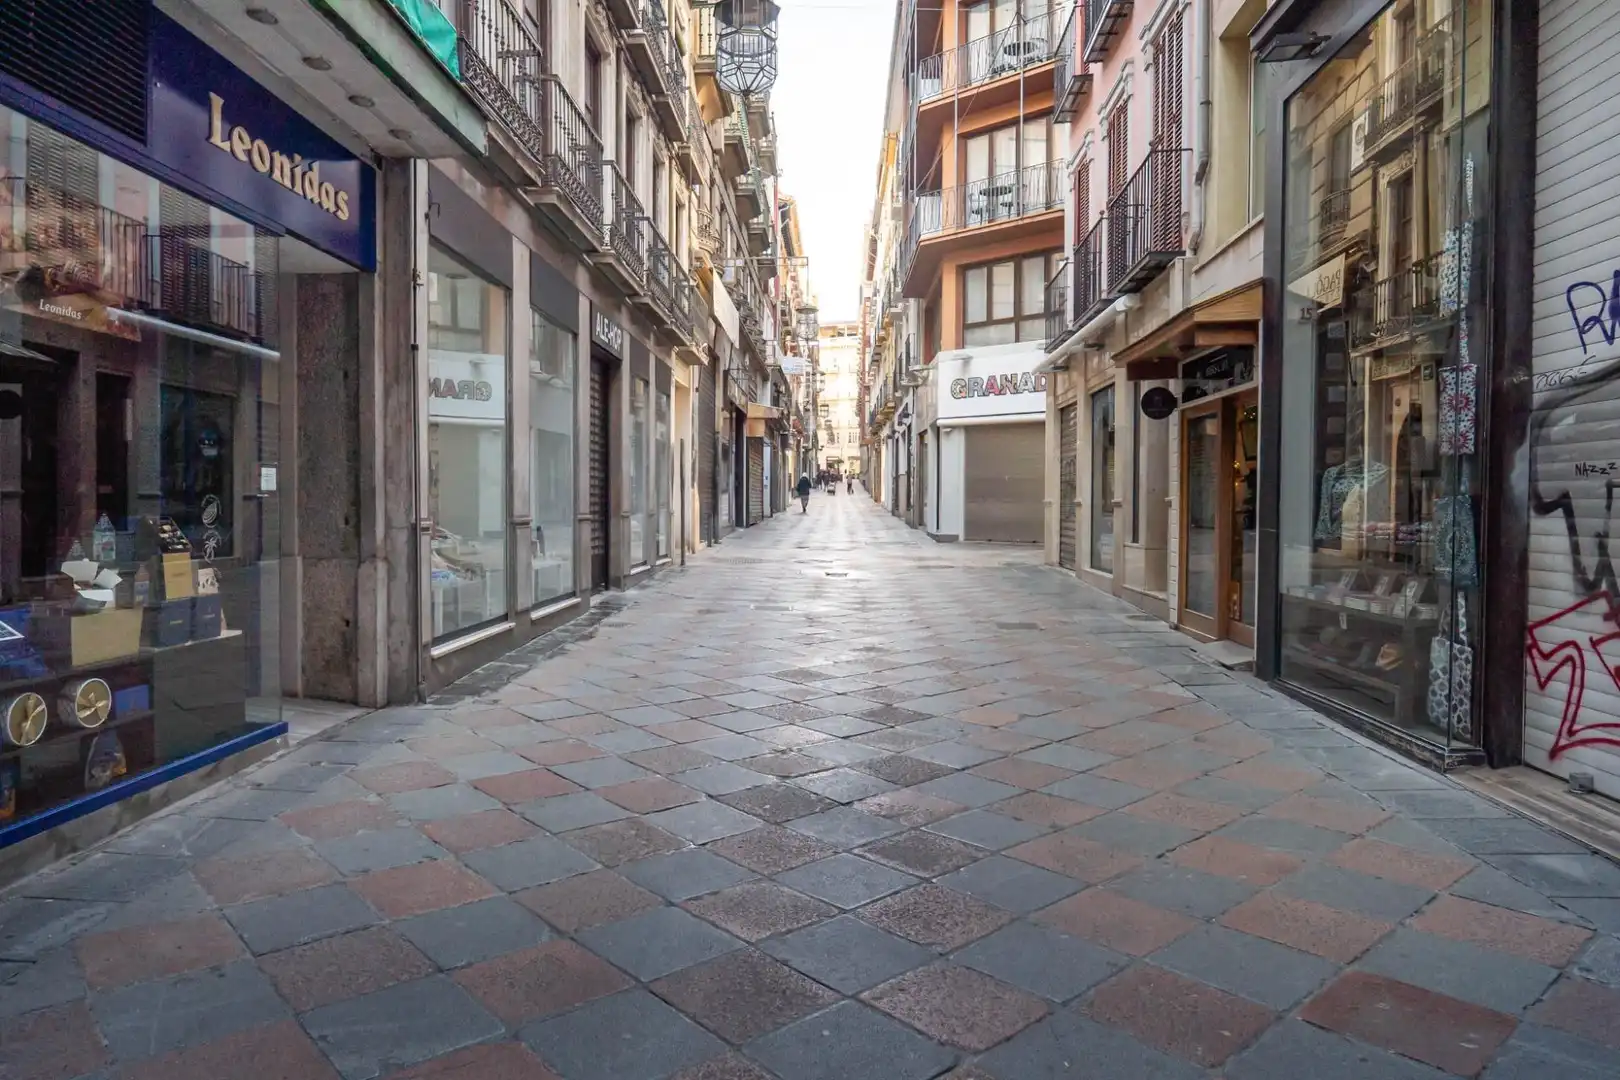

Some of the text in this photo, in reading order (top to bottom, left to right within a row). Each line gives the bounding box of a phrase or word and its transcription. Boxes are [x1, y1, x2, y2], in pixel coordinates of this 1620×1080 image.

[207, 91, 350, 221] Leonidas
[40, 299, 82, 320] Leonidas
[596, 311, 622, 352] ALE-HOP
